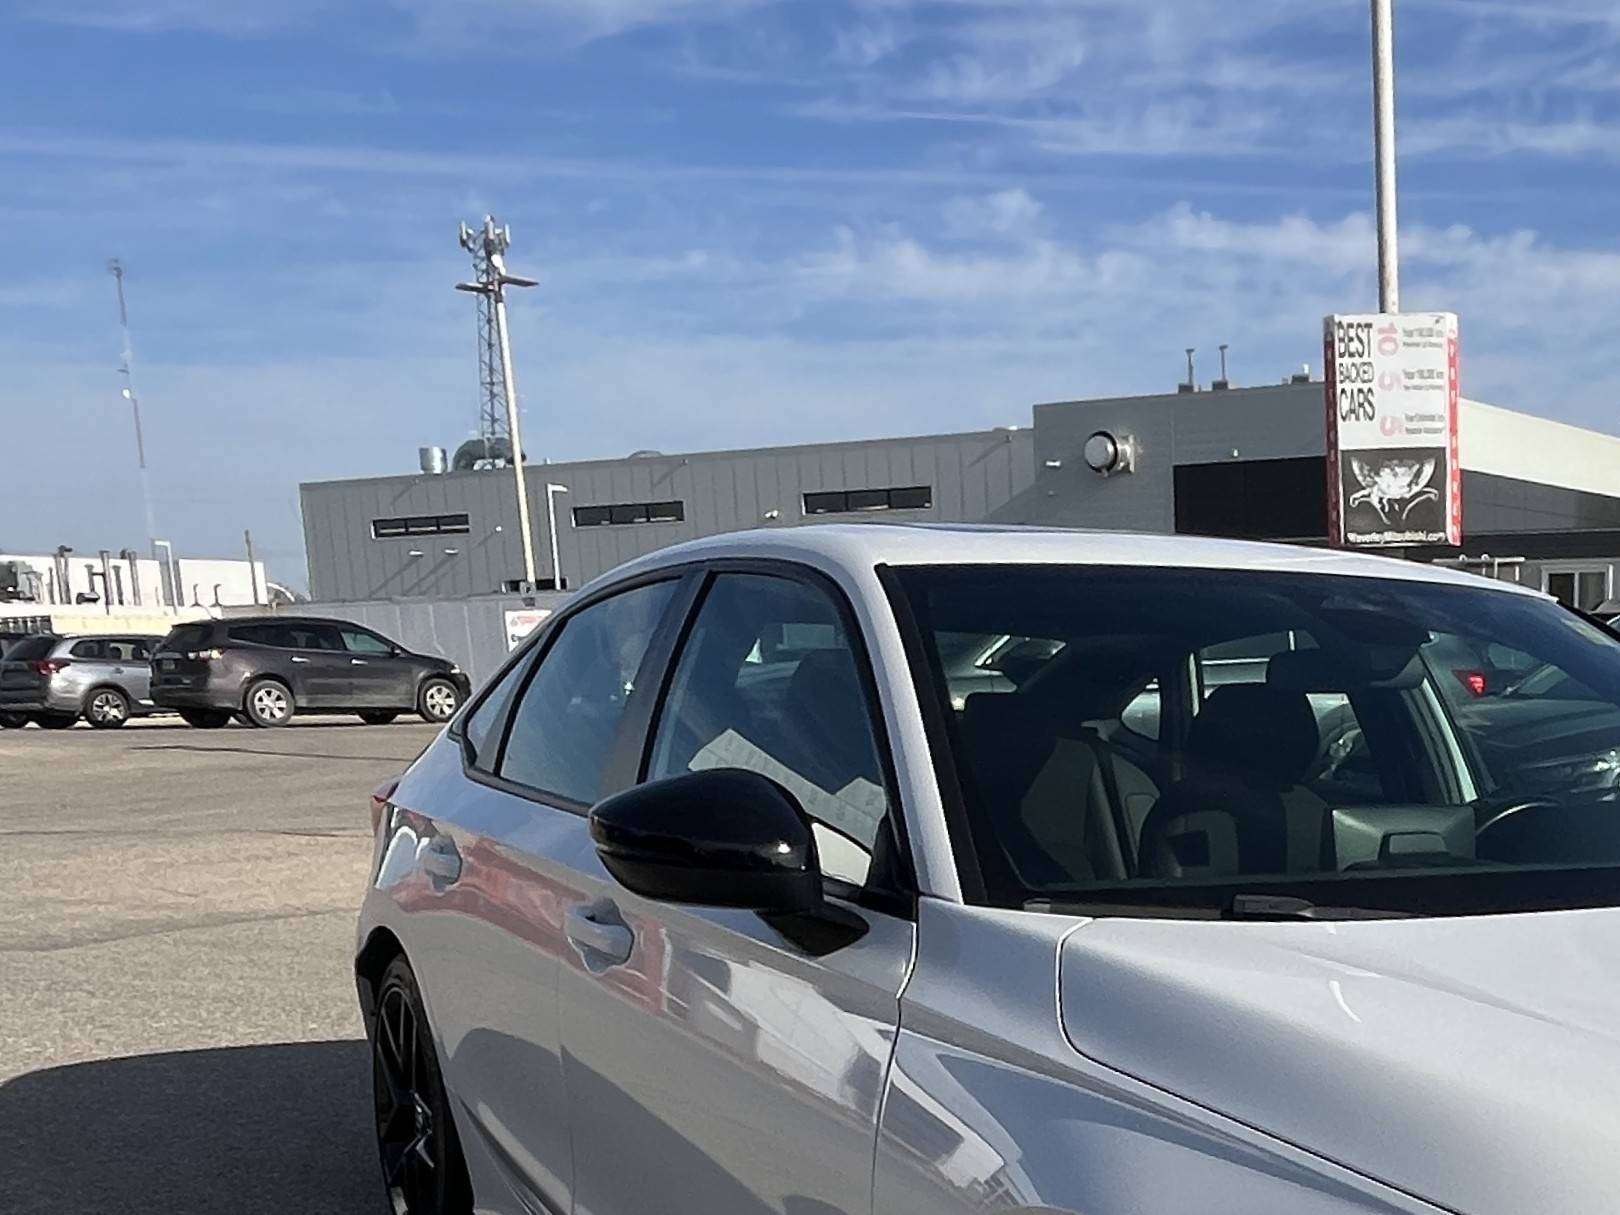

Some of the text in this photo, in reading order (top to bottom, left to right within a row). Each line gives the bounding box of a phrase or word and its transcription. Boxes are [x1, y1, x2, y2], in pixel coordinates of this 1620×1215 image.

[1337, 321, 1373, 358] BEST
[1339, 362, 1375, 384] BACKED
[1340, 388, 1376, 422] CARS
